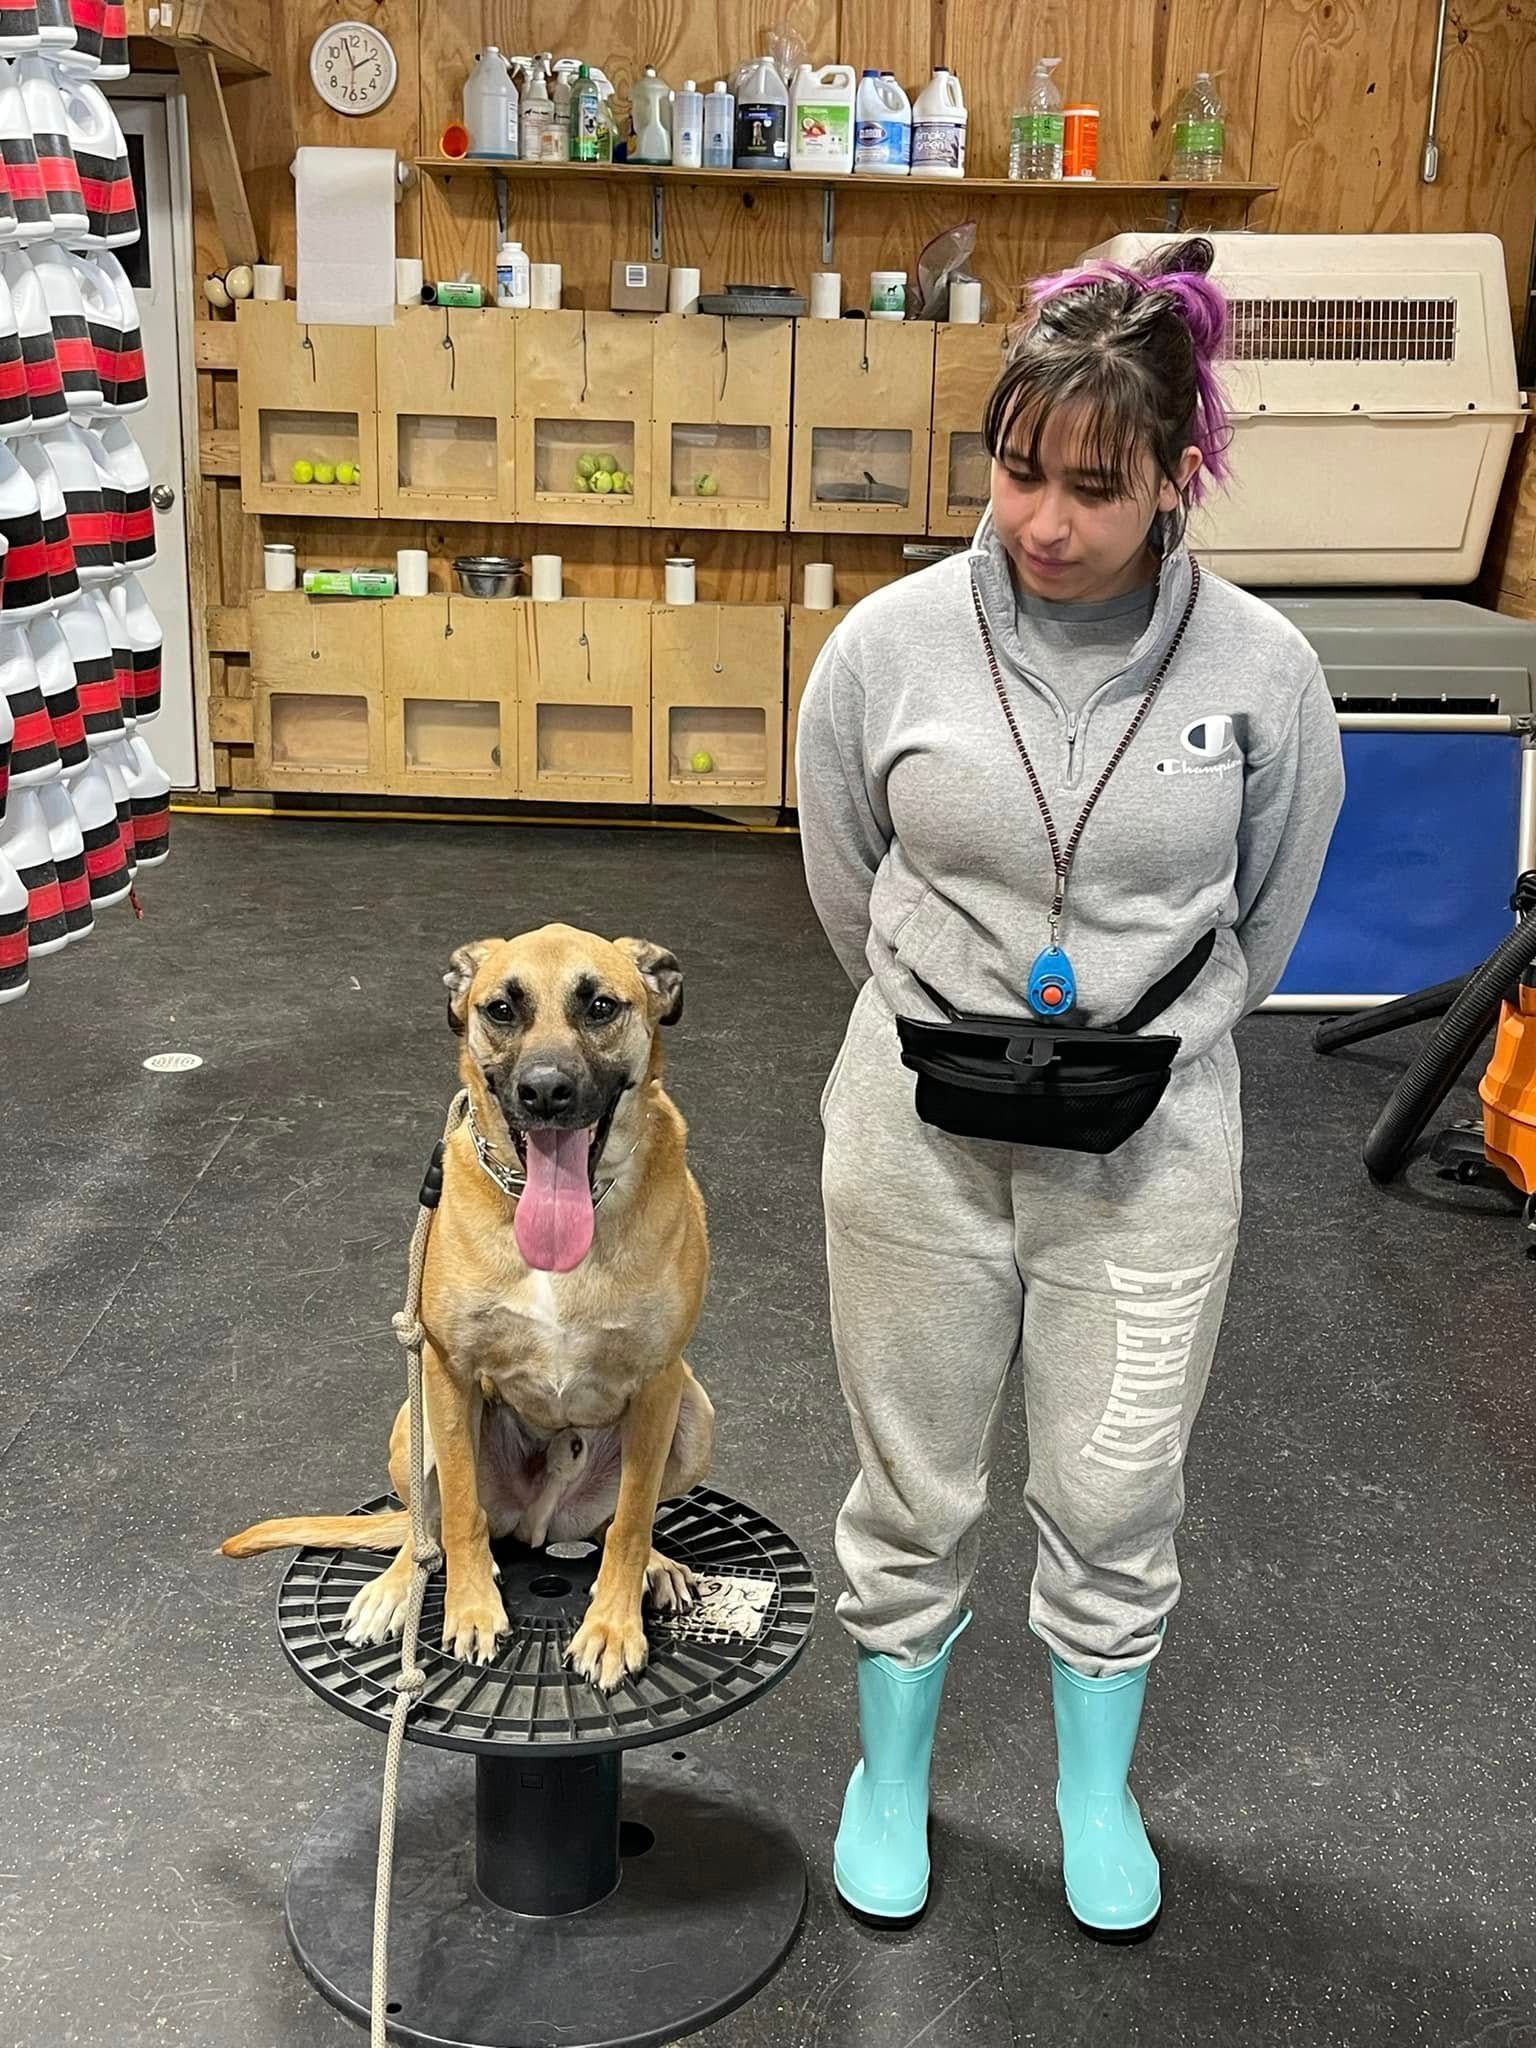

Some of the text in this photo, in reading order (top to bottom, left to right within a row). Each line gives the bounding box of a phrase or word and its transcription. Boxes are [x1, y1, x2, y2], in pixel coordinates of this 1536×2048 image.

[348, 35, 360, 48] 12
[328, 46, 340, 59] 10
[370, 48, 378, 61] 2
[325, 60, 334, 72] 9
[374, 64, 382, 77] 3
[330, 75, 338, 88] 8
[369, 78, 377, 90] 4
[341, 86, 348, 98] 7
[349, 89, 358, 102] 6
[360, 88, 368, 100] 5
[1079, 1251, 1224, 1472] EVERLAST
